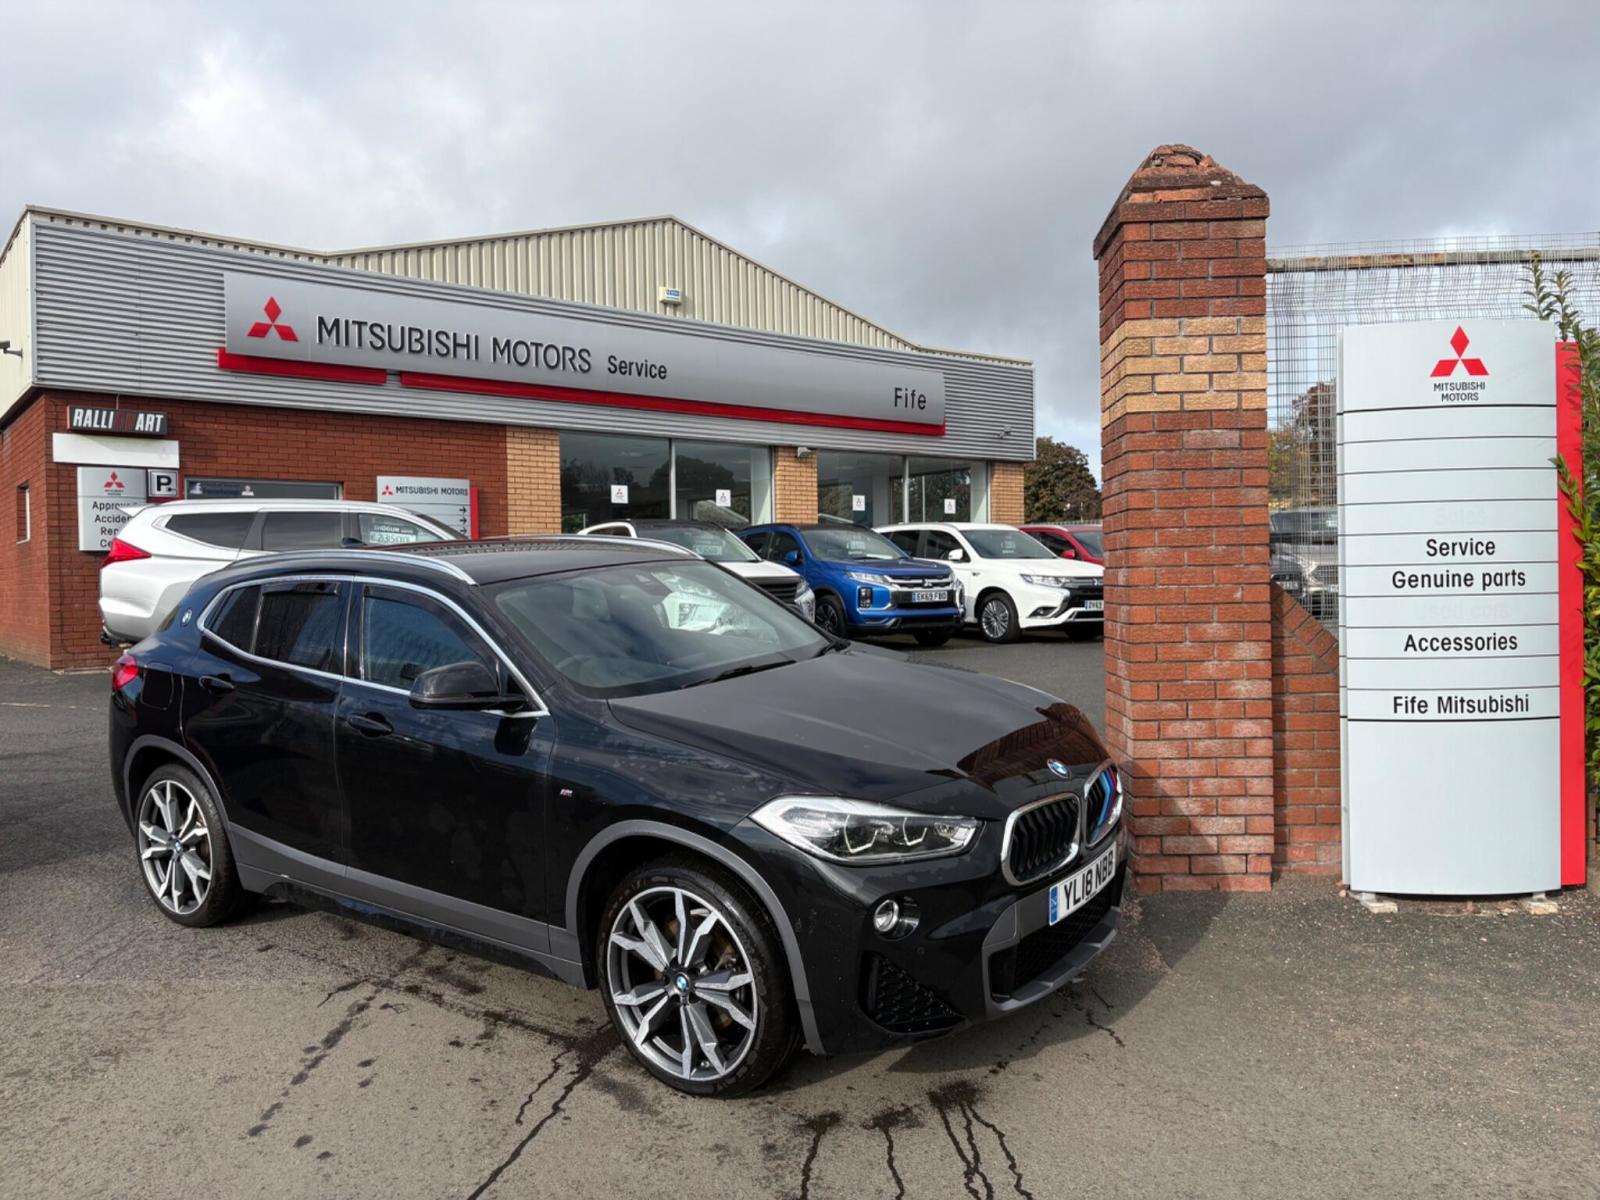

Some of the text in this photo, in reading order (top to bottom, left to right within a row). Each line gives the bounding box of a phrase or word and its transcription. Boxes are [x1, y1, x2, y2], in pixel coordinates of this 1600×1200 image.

[316, 314, 667, 380] MITSUBISHI MOTORS Service
[1433, 382, 1486, 392] MITSUBISHI
[894, 387, 927, 410] Fife
[1441, 393, 1480, 402] MOTORS
[395, 485, 468, 497] MITSUBISHI MOTORS
[1426, 538, 1496, 557] Service
[1392, 569, 1526, 591] Genuine parts
[1404, 633, 1518, 652] Accessories
[1393, 694, 1529, 714] Fife Mitsubishi
[1064, 868, 1093, 910] YL18
